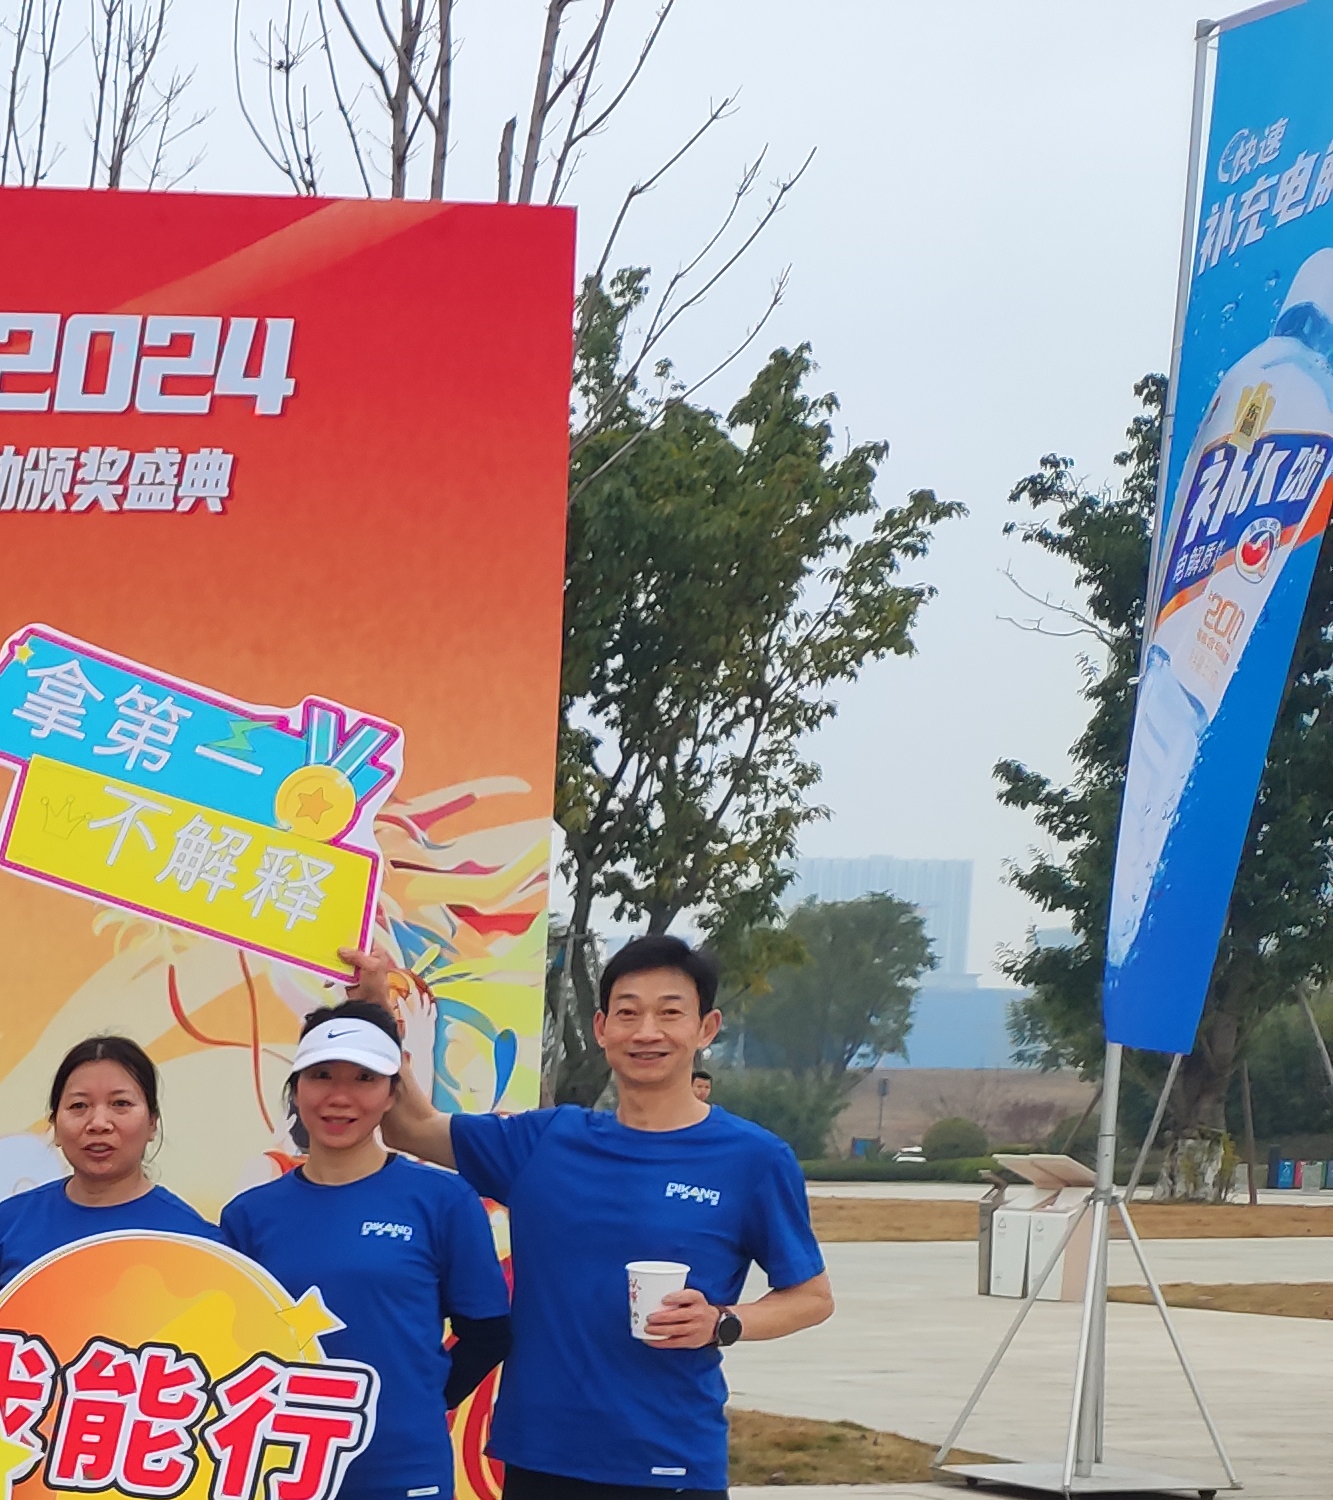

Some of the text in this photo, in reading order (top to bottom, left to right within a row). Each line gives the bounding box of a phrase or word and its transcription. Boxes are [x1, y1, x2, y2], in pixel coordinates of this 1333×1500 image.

[11, 656, 264, 778] 拿第一
[88, 785, 335, 931] 不解释
